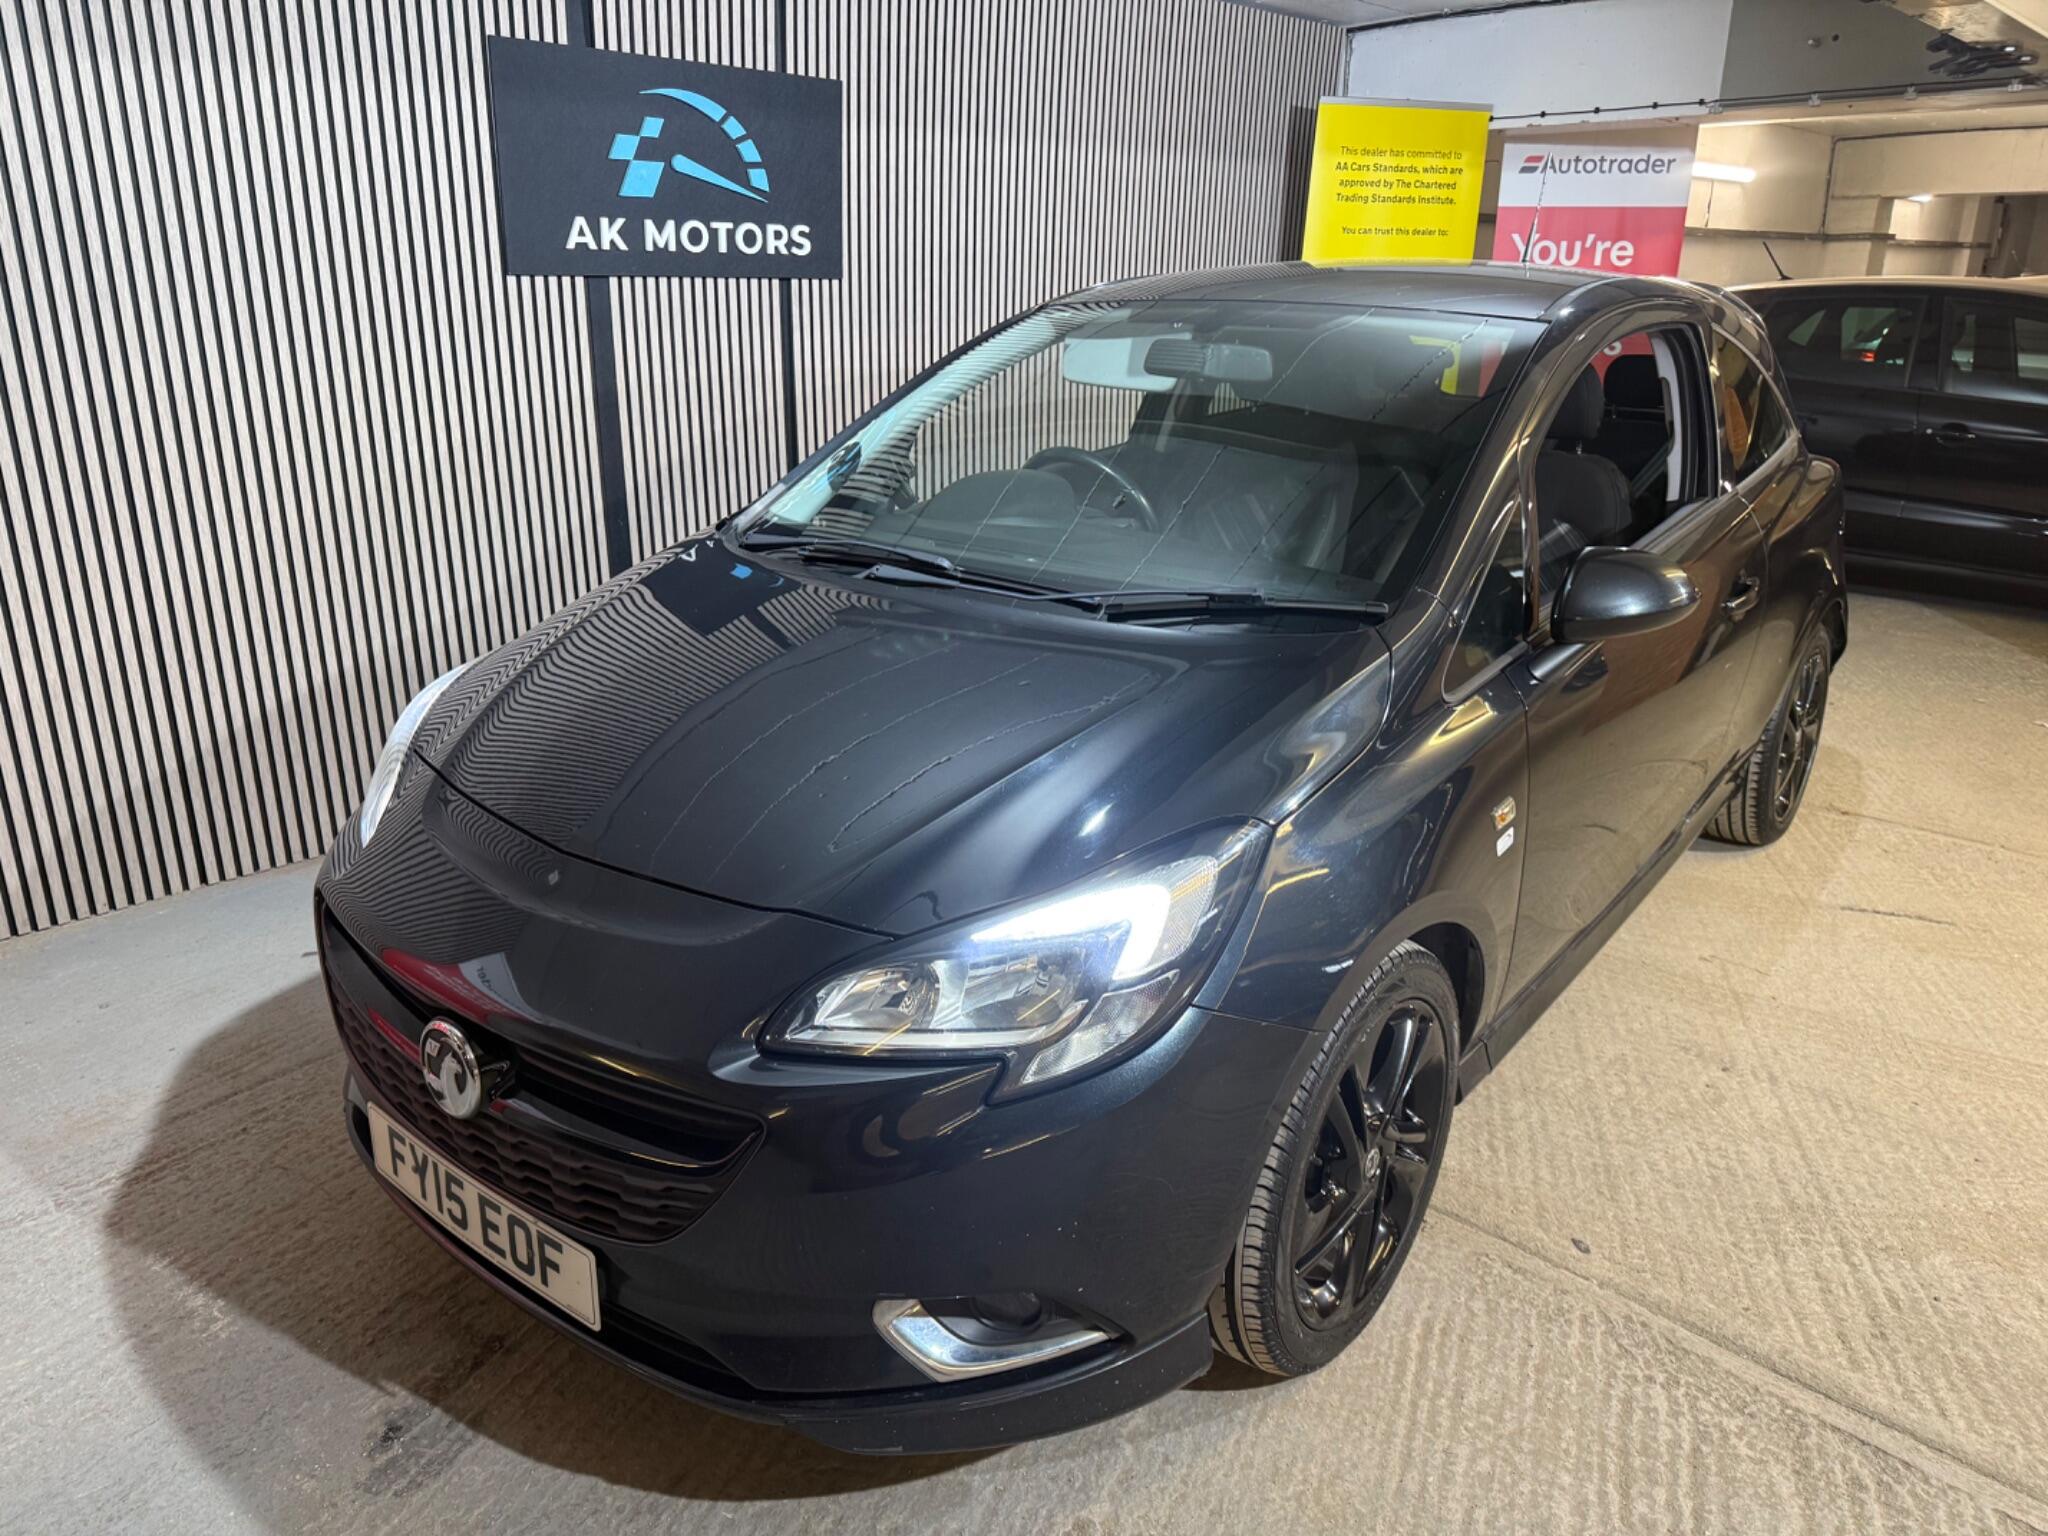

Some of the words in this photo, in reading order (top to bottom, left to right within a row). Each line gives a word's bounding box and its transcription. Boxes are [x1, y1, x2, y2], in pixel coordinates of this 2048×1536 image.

[1340, 146, 1358, 156] This
[1360, 147, 1388, 157] dealer
[1389, 148, 1405, 158] has
[1406, 149, 1452, 160] committed
[1453, 151, 1463, 160] to
[1335, 161, 1349, 171] AA
[1350, 162, 1370, 172] Cars
[1372, 163, 1420, 174] Standards,
[1422, 165, 1448, 175] which
[1449, 167, 1464, 175] are
[1540, 153, 1677, 175] Autotrader
[1339, 179, 1381, 189] approved
[1383, 179, 1394, 190] by
[1395, 179, 1412, 189] The
[1413, 180, 1457, 190] Chartered
[1336, 193, 1369, 205] Trading
[1371, 194, 1416, 204] Standards
[1418, 195, 1457, 205] Institute.
[565, 215, 629, 251] AK
[643, 218, 812, 256] MOTORS
[1342, 226, 1356, 235] You
[1374, 227, 1394, 236] trust
[1395, 227, 1410, 236] this
[1411, 228, 1437, 237] dealer
[1438, 228, 1449, 237] to:
[387, 1125, 469, 1231] FY15
[477, 1192, 564, 1288] EOF
